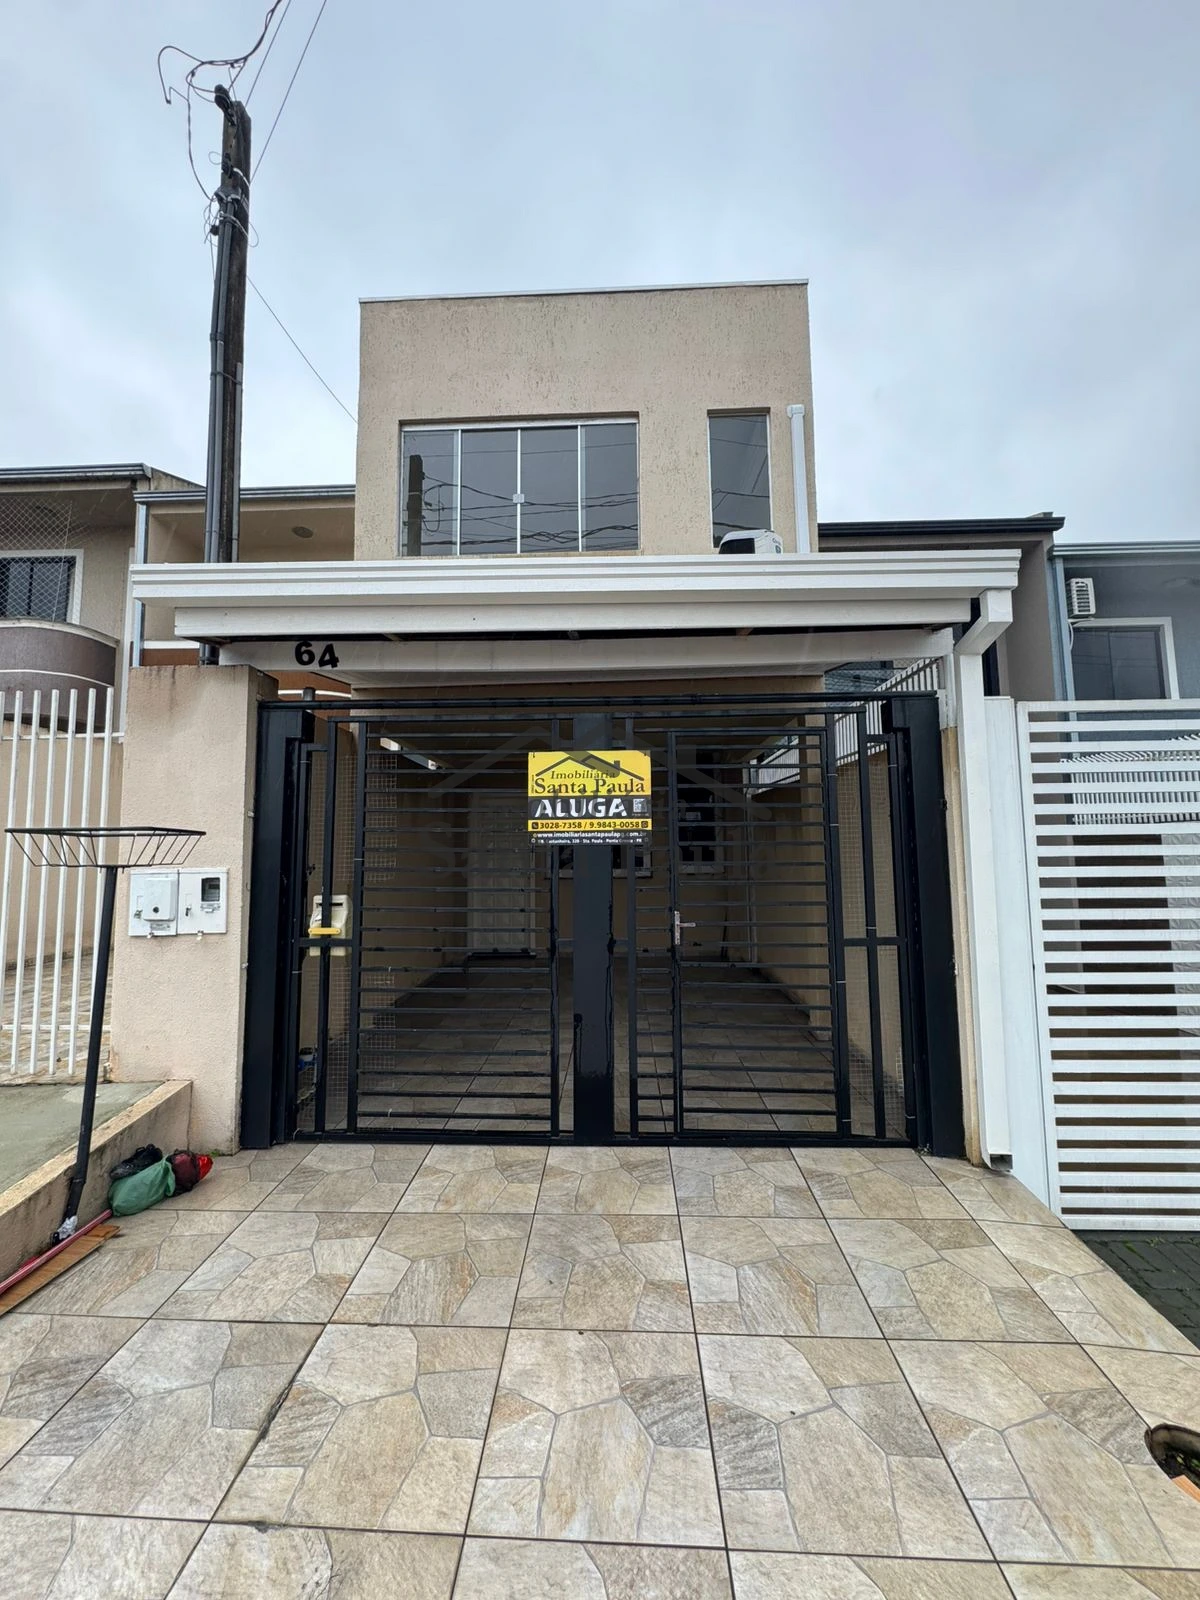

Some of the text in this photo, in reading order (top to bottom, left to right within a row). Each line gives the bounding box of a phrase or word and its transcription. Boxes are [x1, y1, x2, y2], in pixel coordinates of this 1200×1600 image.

[294, 640, 340, 669] 64
[551, 770, 616, 780] Imobiliária
[535, 777, 587, 794] Santa
[592, 777, 645, 794] Paula
[534, 798, 628, 818] ALUGA
[589, 820, 640, 829] 9.9843-0058
